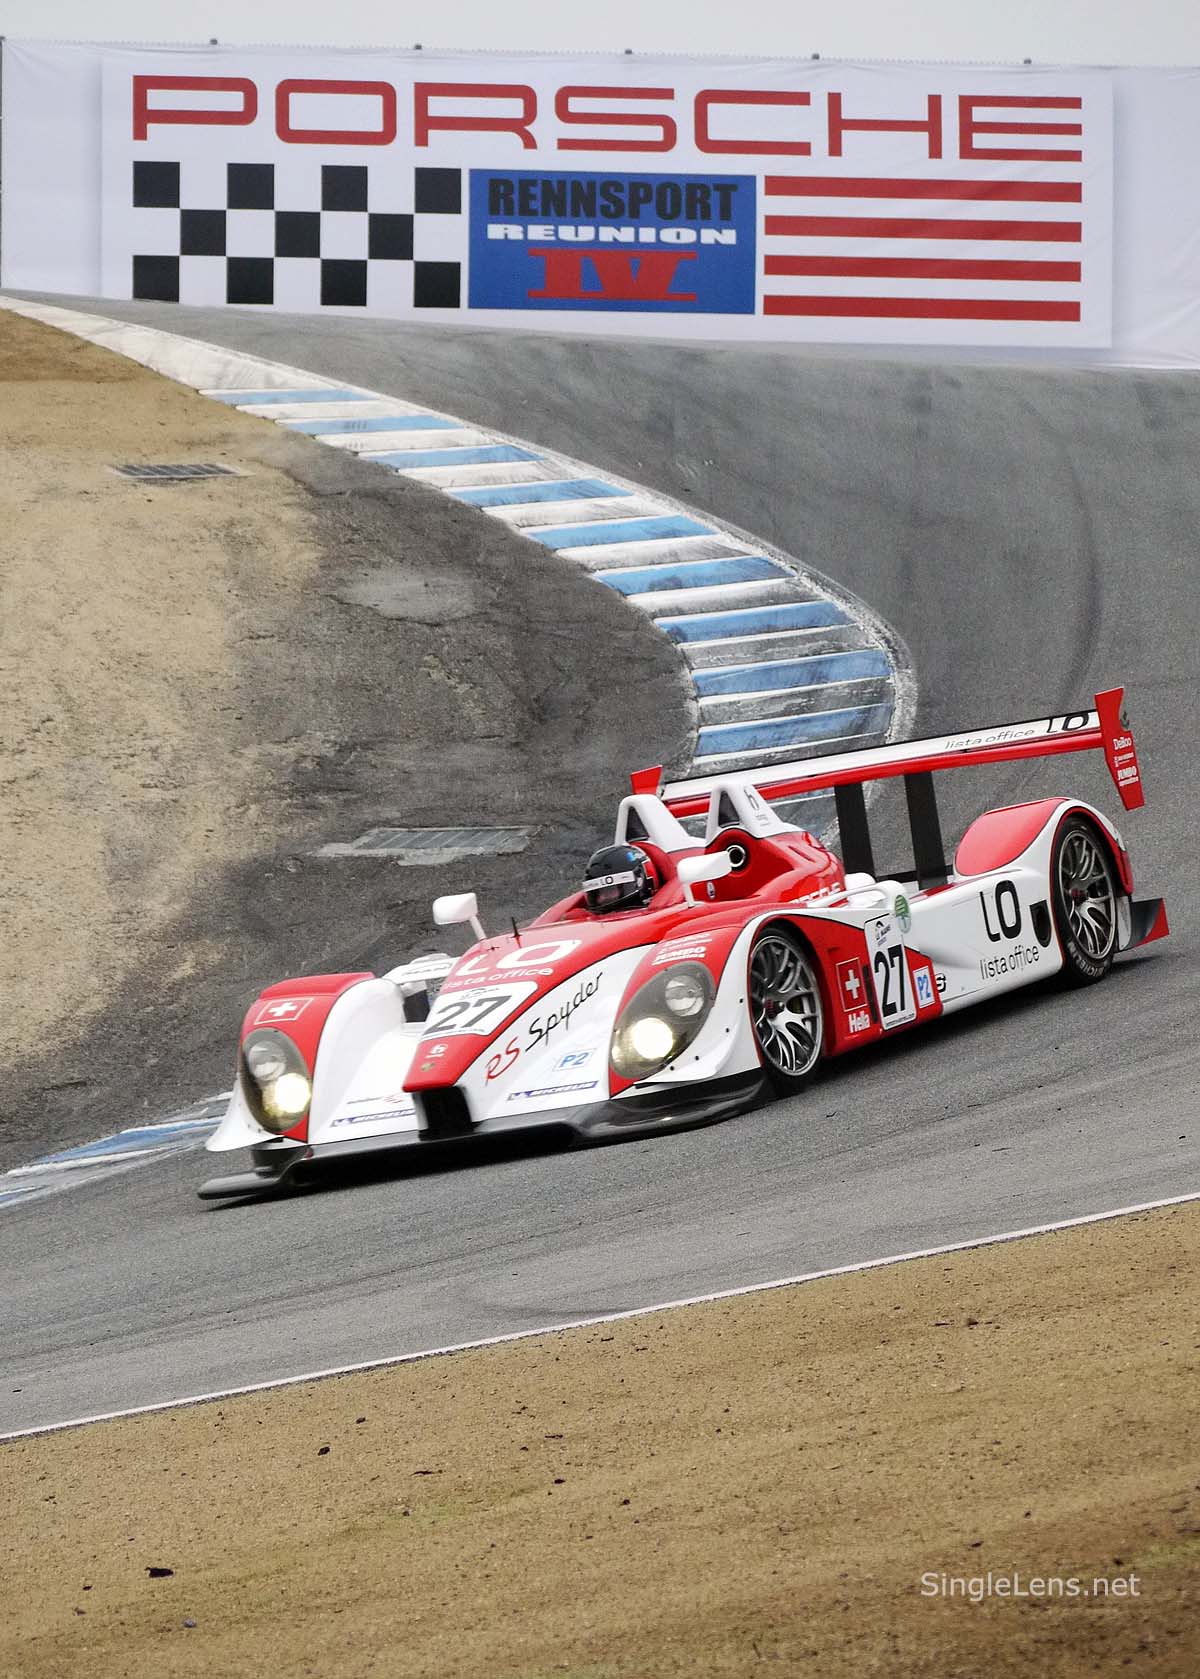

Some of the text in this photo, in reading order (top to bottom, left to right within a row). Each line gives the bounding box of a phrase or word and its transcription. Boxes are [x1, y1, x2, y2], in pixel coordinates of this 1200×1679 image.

[132, 74, 1083, 161] PORSCHE
[488, 178, 738, 221] RENNSPORT
[487, 224, 737, 245] REUNION
[527, 247, 698, 302] IV
[944, 712, 1089, 749] lista office LO
[979, 880, 1022, 943] LO
[455, 939, 583, 976] LO
[486, 967, 554, 982] office
[980, 944, 1040, 980] lista office
[874, 944, 905, 1018] 27
[917, 974, 932, 1001] P2
[423, 995, 513, 1036] 27
[484, 971, 603, 1087] RS Spyder
[560, 1052, 589, 1068] P2
